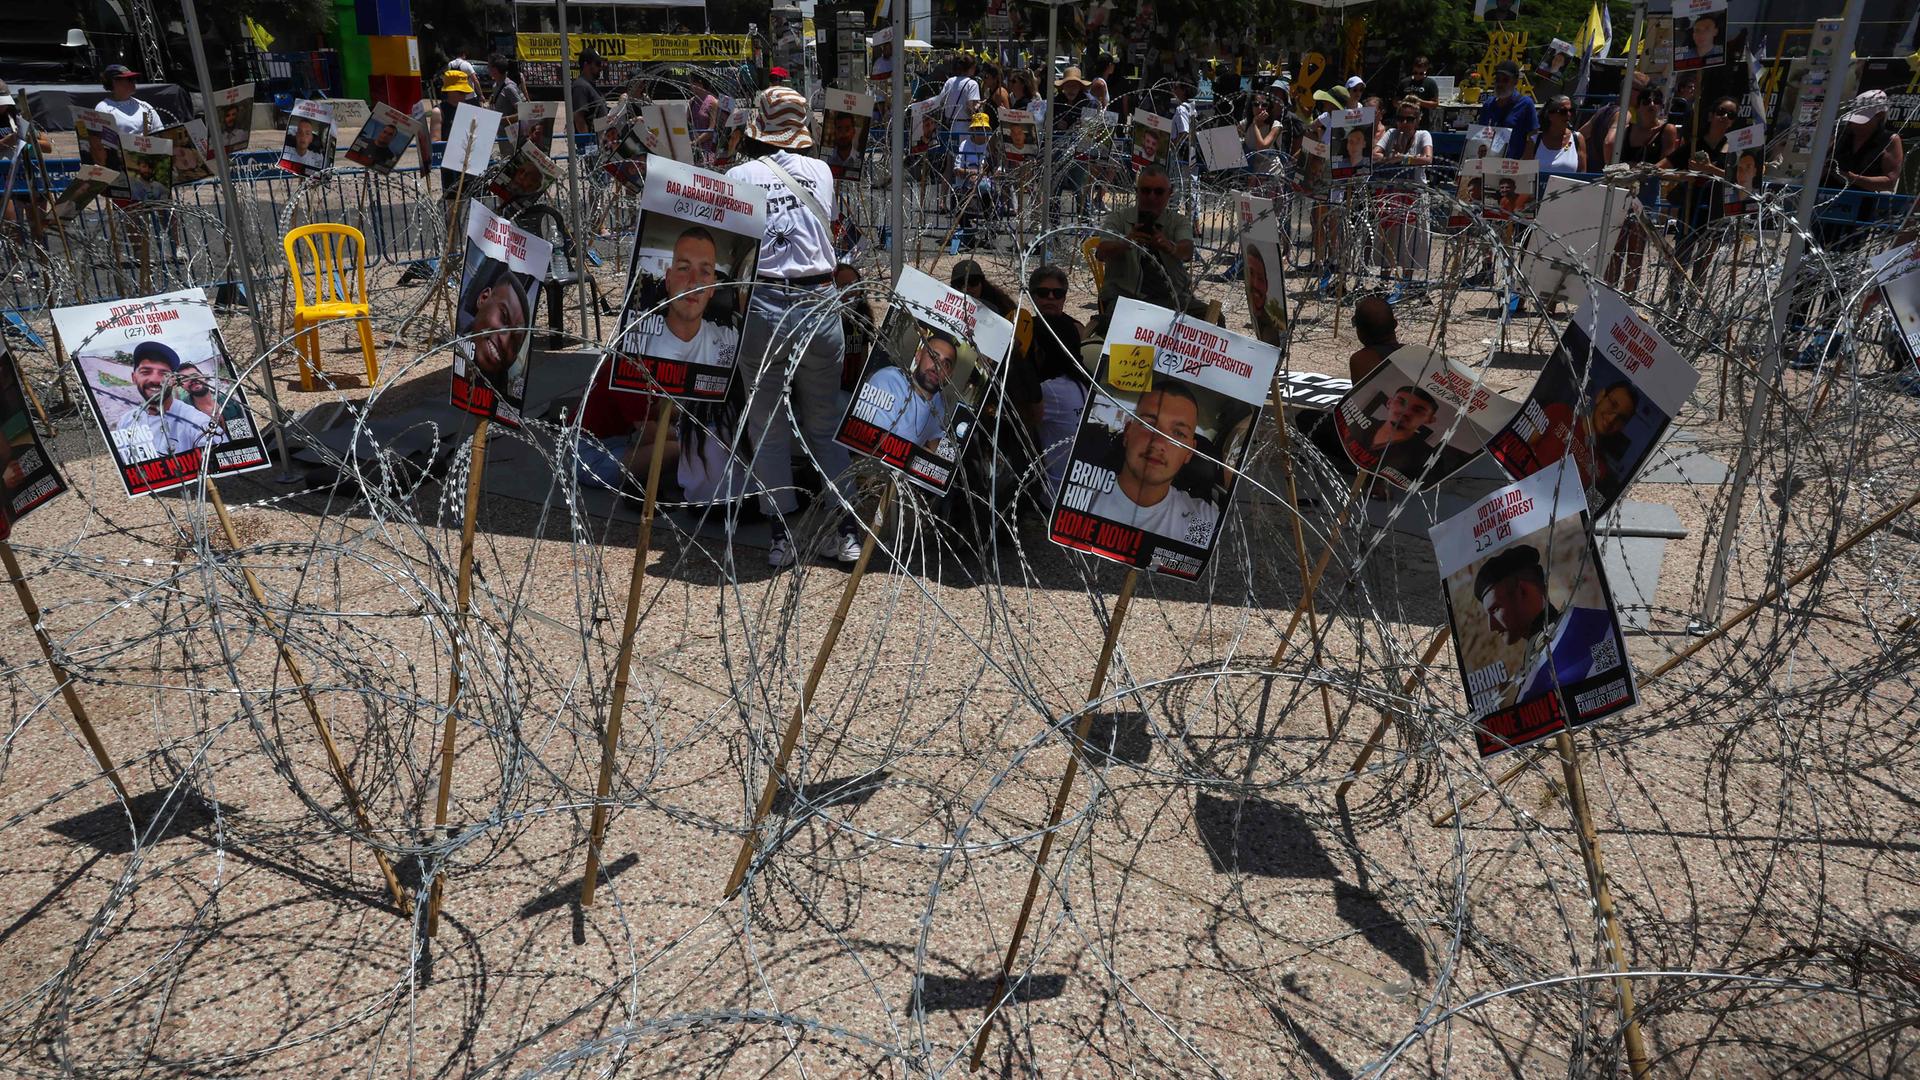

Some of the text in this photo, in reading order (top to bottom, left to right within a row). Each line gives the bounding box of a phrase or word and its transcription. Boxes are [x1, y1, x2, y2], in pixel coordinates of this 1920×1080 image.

[1488, 31, 1528, 46] YOU
[666, 181, 682, 196] BAR
[682, 185, 715, 205] ABRAHAM
[715, 194, 753, 216] KUPERSHTEIN
[133, 315, 145, 325] ZIV
[146, 309, 180, 324] BERMAN
[934, 299, 956, 316] SEGEV
[124, 327, 145, 339] (27)
[1171, 322, 1229, 353] בר קופרשטיין
[1610, 322, 1629, 346] TAMIR
[1626, 338, 1655, 369] NIMRODI
[1134, 326, 1253, 379] BAR ABRAHAM KUPERSHTEIN
[1157, 351, 1183, 371] (23)
[1606, 342, 1627, 363] (20)
[1430, 371, 1447, 387] ROM
[860, 382, 895, 411] BRING
[852, 399, 878, 423] HIM
[1344, 399, 1372, 430] BRING
[1524, 397, 1550, 435] BRING
[110, 424, 154, 447] BRNG
[1512, 414, 1535, 442] HIM
[1069, 459, 1116, 494] BRING
[1061, 484, 1094, 512] HIM
[1505, 489, 1522, 506] מתן
[1054, 509, 1144, 556] HOME NOW!
[1472, 498, 1534, 539] MATAN ANGREST
[1474, 534, 1493, 552] 22
[1467, 660, 1509, 695] BRING
[1518, 691, 1560, 730] NOW!
[1576, 685, 1628, 715] FAMILIES FORUM
